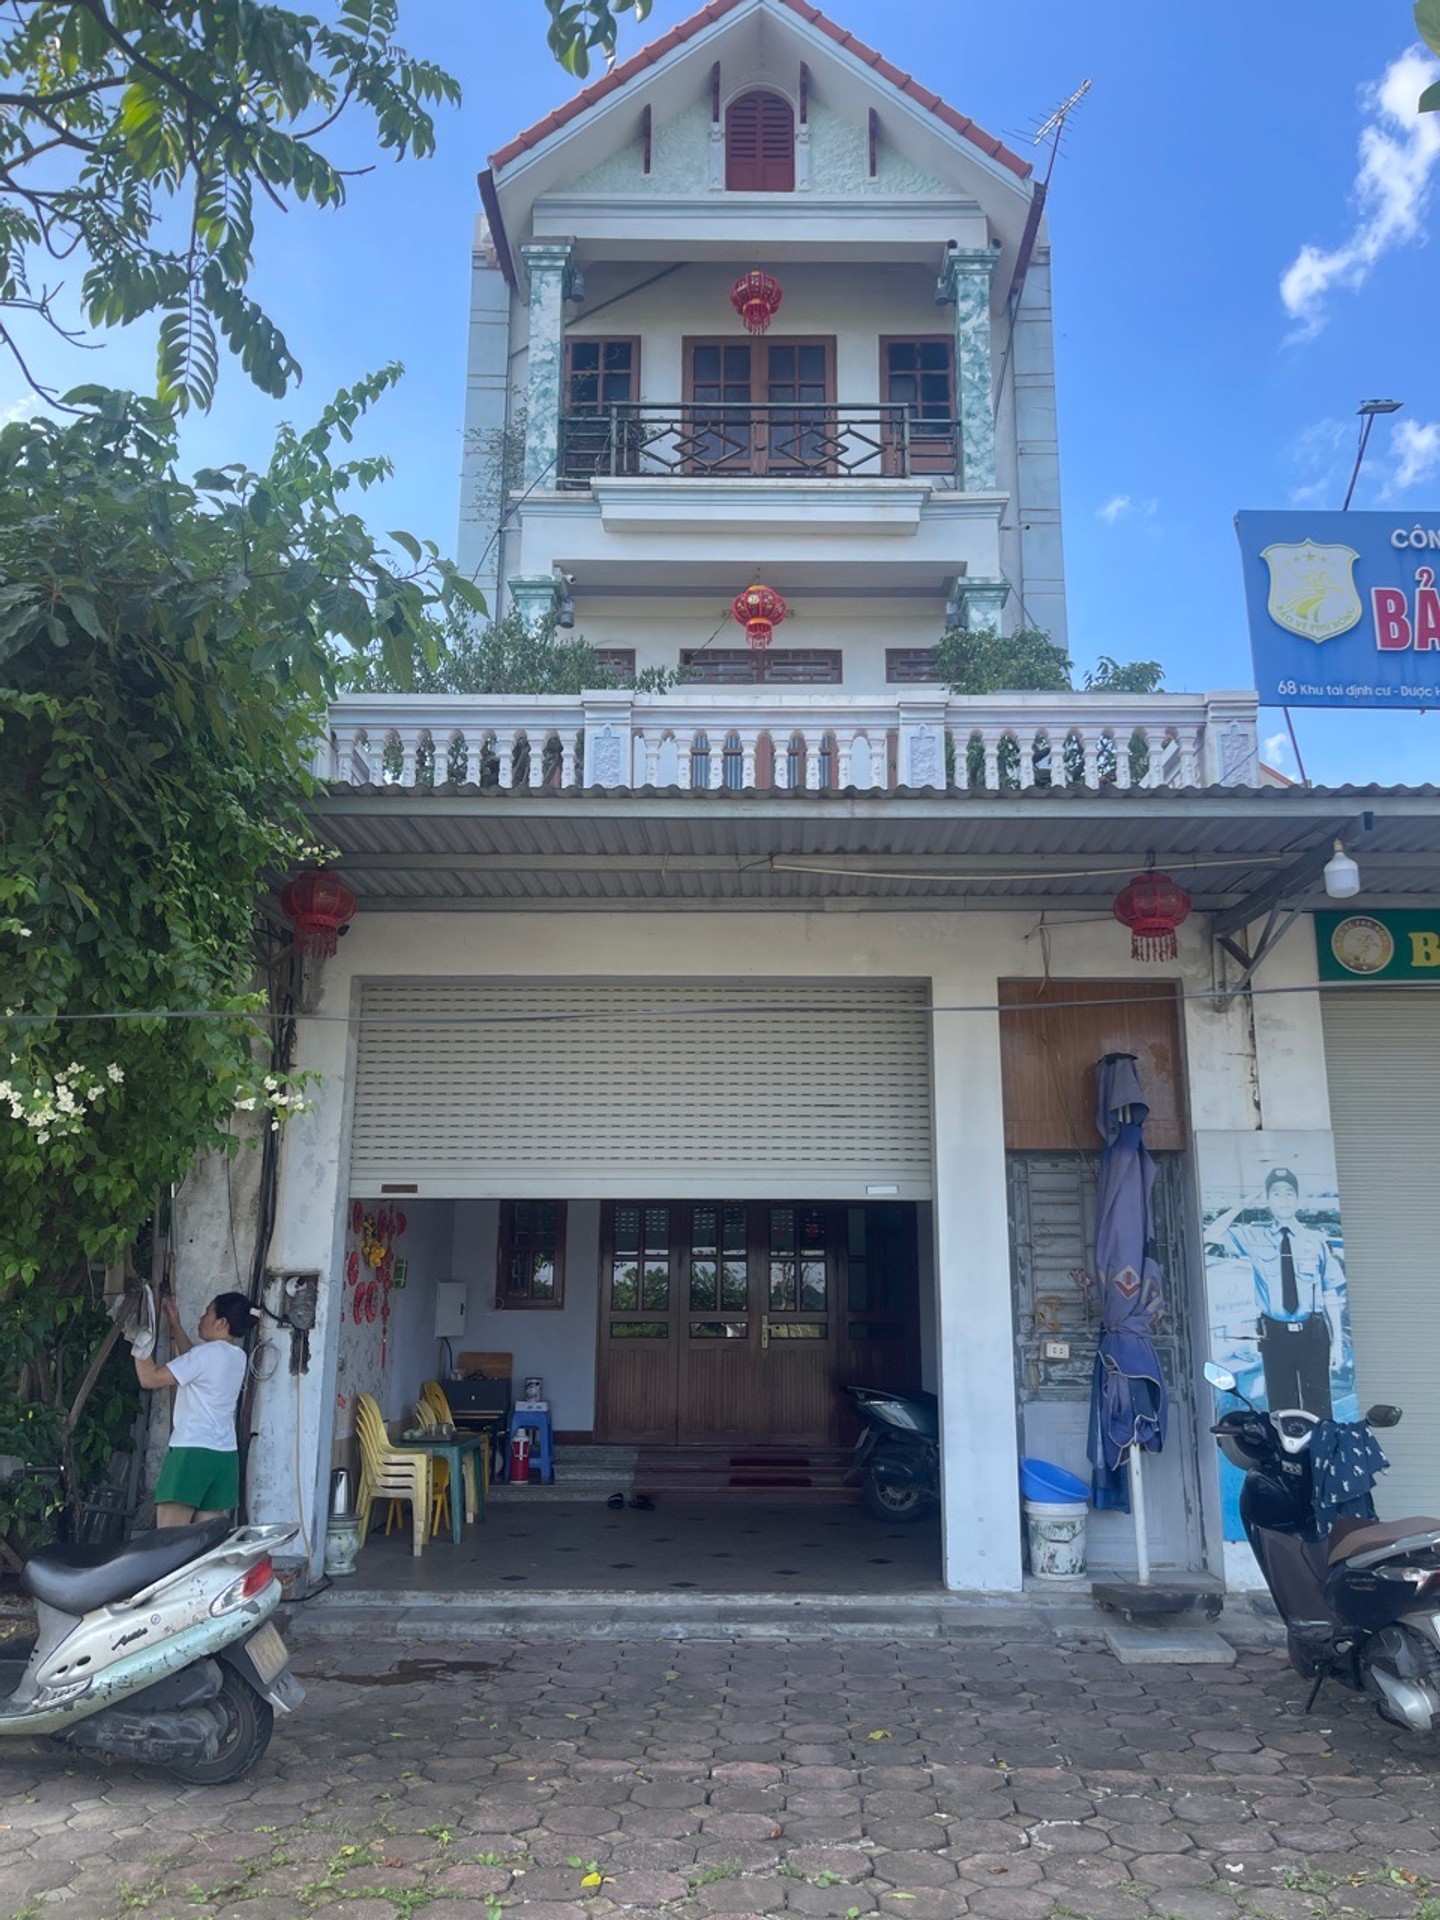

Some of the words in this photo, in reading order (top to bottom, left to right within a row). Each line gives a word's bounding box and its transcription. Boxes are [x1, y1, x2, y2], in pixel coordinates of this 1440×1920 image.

[1391, 523, 1440, 549] CÔN
[1371, 566, 1440, 651] BẢ
[1277, 680, 1297, 695] 68
[1300, 684, 1323, 696] Khu
[1408, 931, 1440, 968] B
